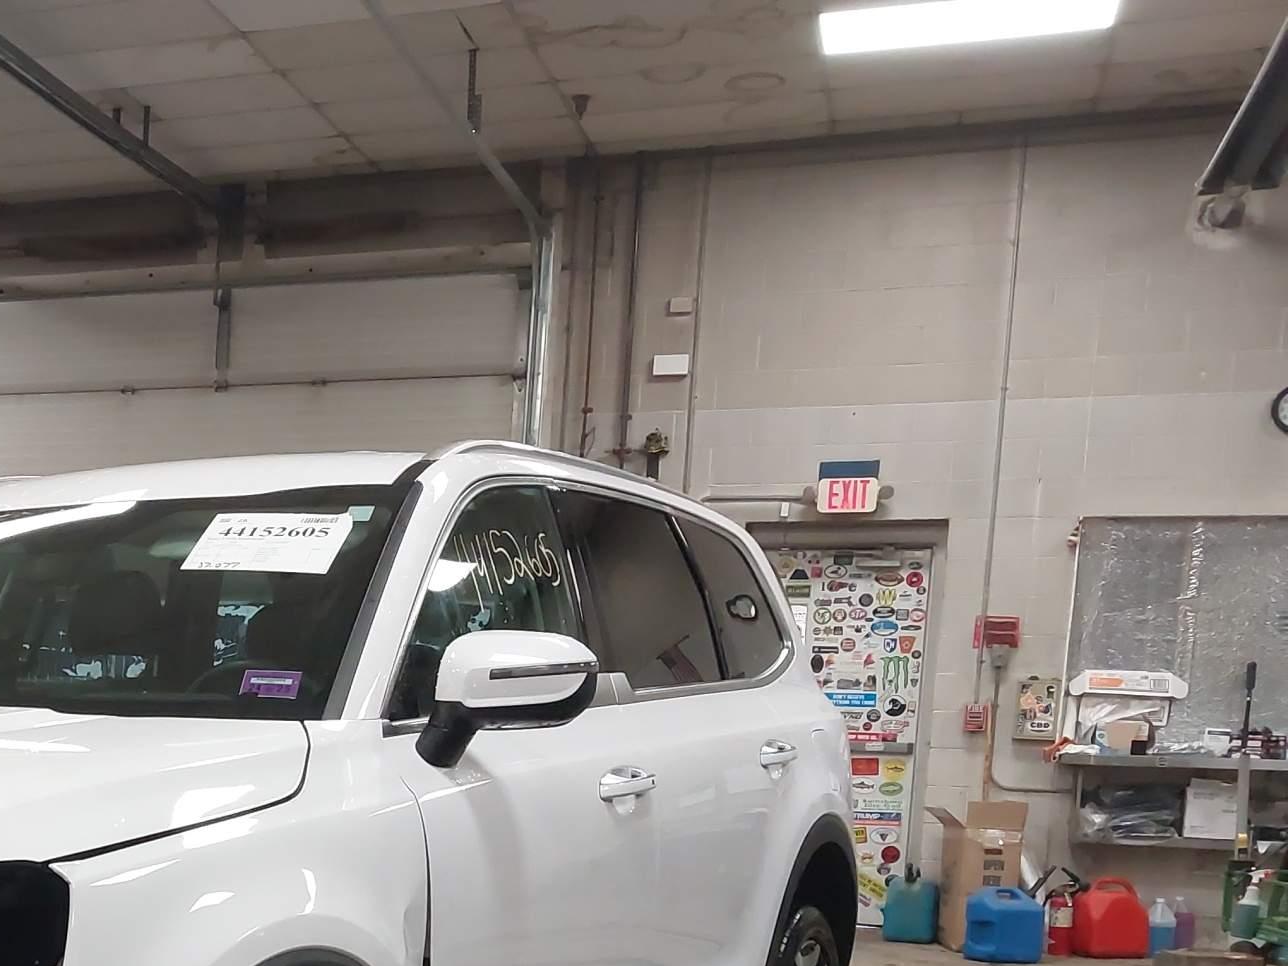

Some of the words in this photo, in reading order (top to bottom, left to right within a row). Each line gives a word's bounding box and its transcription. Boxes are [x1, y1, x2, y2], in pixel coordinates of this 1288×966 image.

[828, 479, 871, 509] EXIT
[218, 526, 332, 538] 44152605
[850, 609, 865, 618] STP
